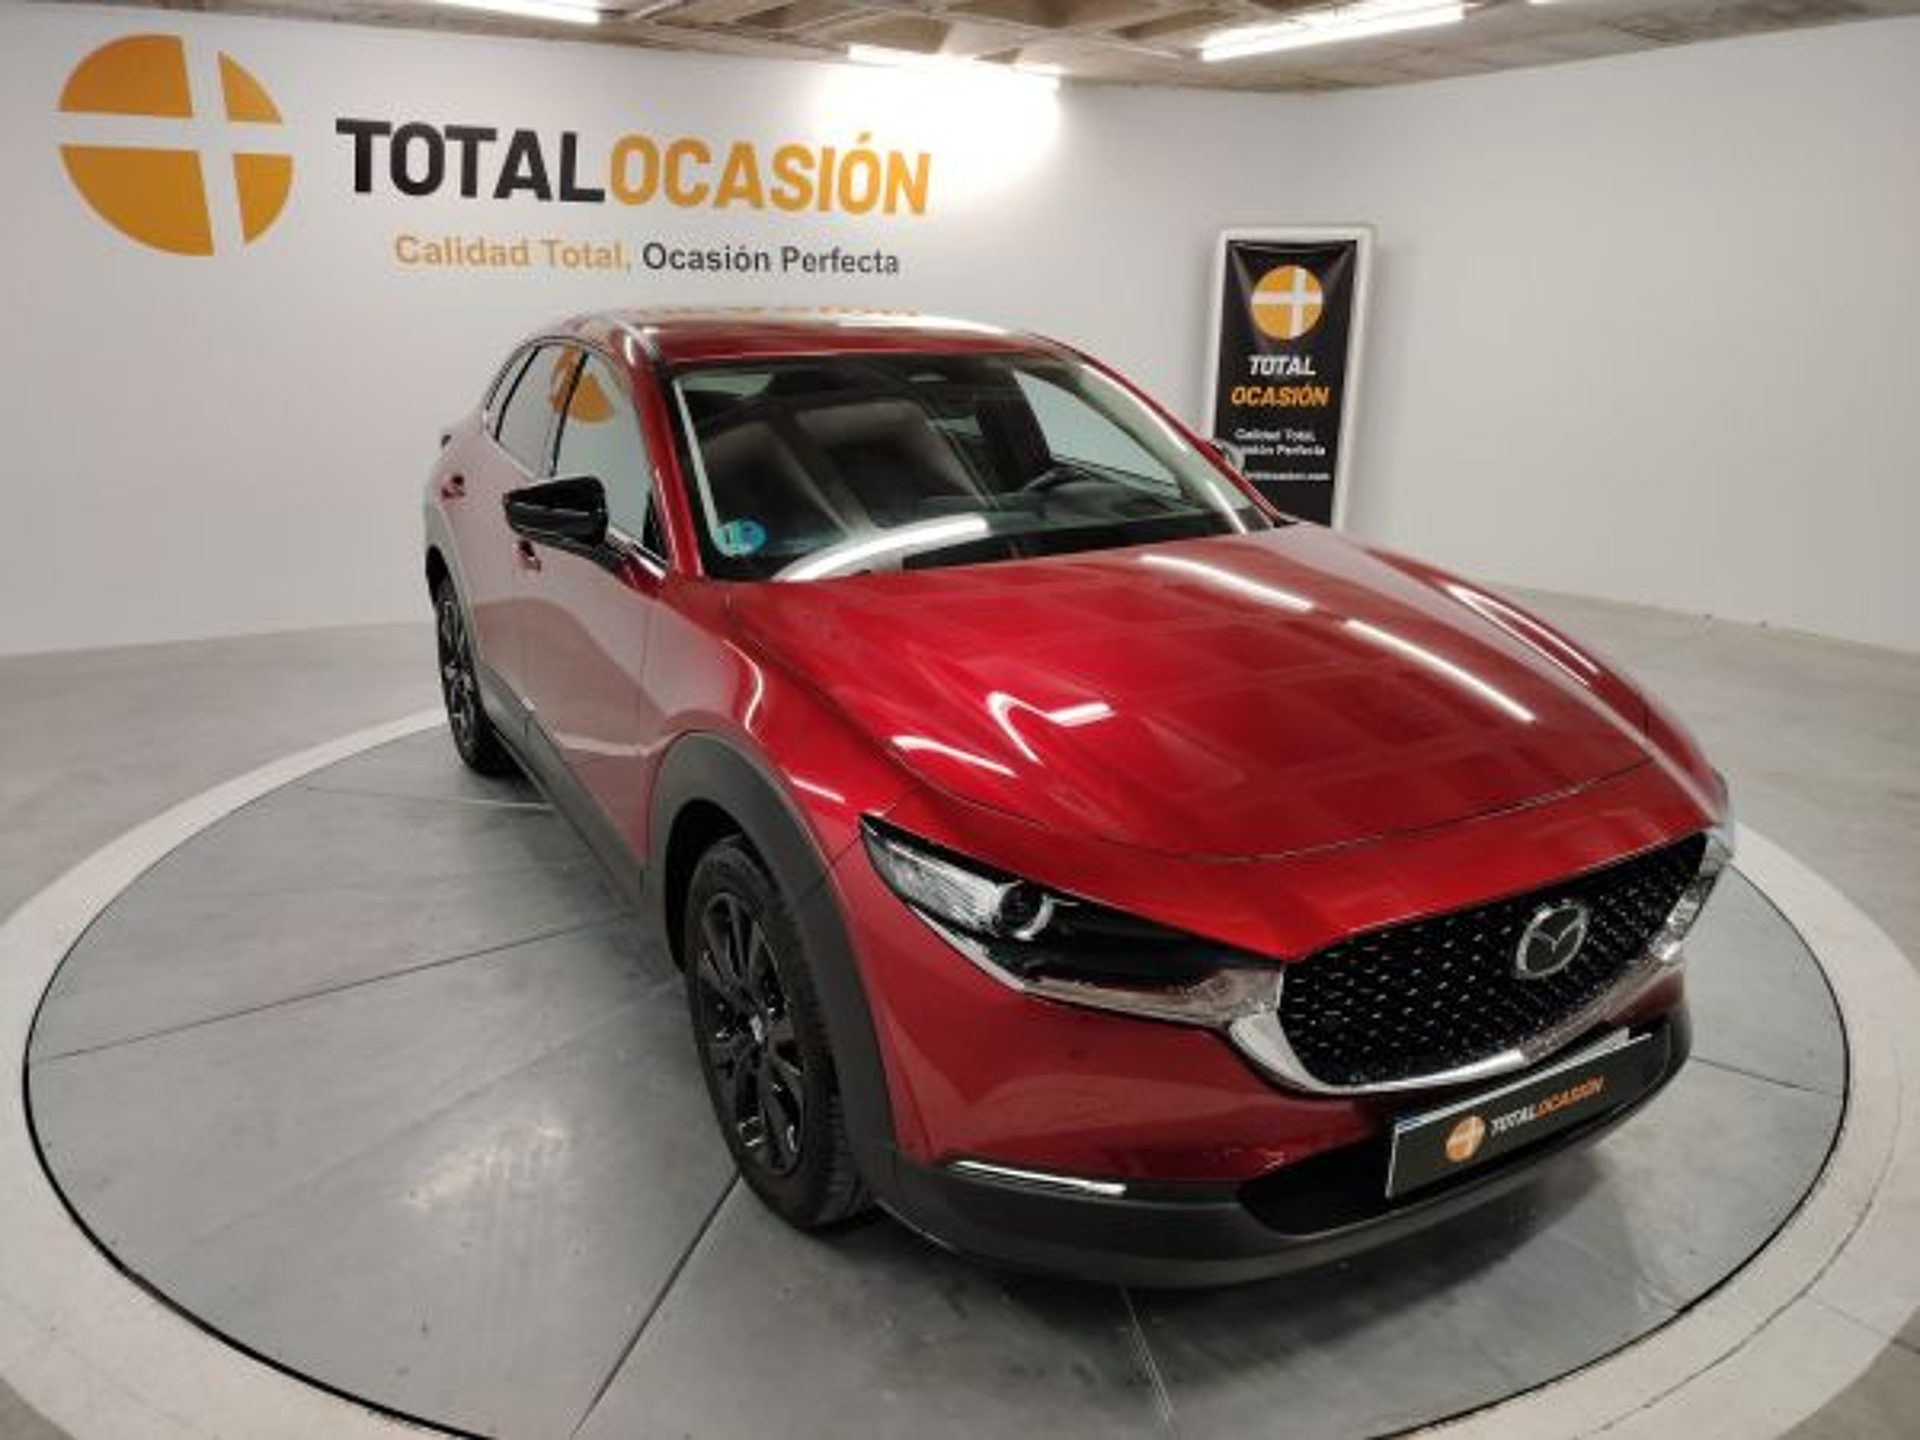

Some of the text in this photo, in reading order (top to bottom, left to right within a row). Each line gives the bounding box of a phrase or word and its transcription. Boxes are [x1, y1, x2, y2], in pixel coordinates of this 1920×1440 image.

[394, 235, 900, 274] Calidad Total, Ocasión Perfecta
[1248, 355, 1316, 376] TOTAL
[1231, 384, 1330, 408] OCASIÓN
